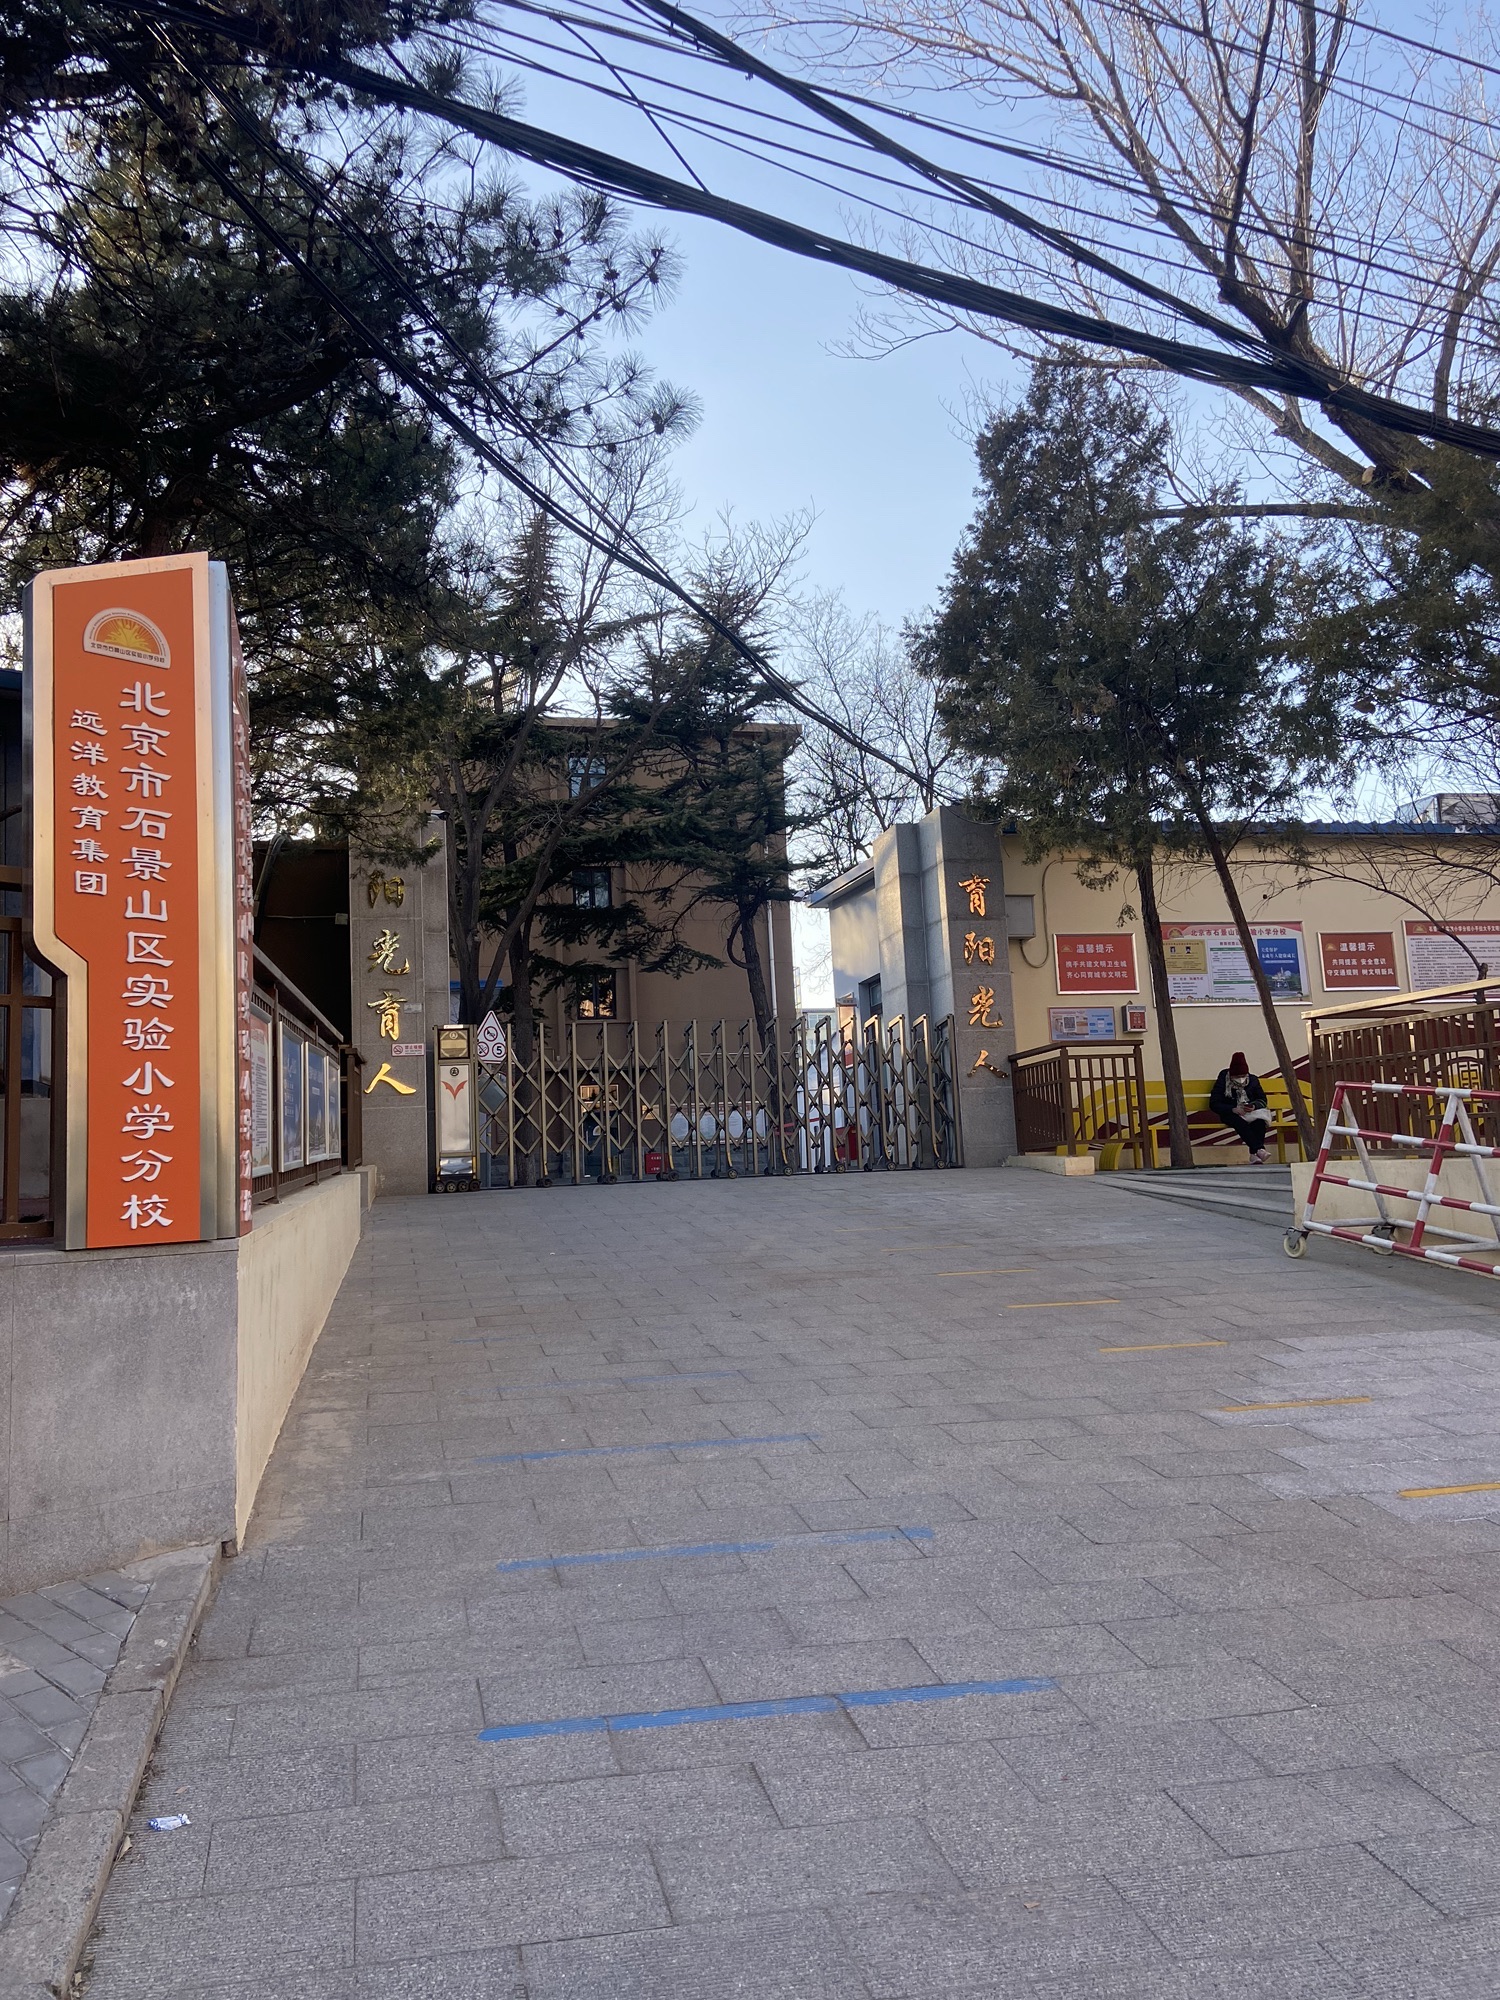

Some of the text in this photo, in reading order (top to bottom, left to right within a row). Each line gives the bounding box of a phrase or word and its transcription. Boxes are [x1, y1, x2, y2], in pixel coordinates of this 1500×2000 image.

[69, 709, 109, 896] 远洋教育集团
[119, 681, 175, 1230] 北京市石景山区实验小学分校
[364, 869, 417, 1095] 阳光育人
[957, 873, 1010, 1078] 育阳光人
[1076, 944, 1114, 954] 温馨提示
[1340, 942, 1375, 951] 温馨提示
[496, 1045, 503, 1055] 5
